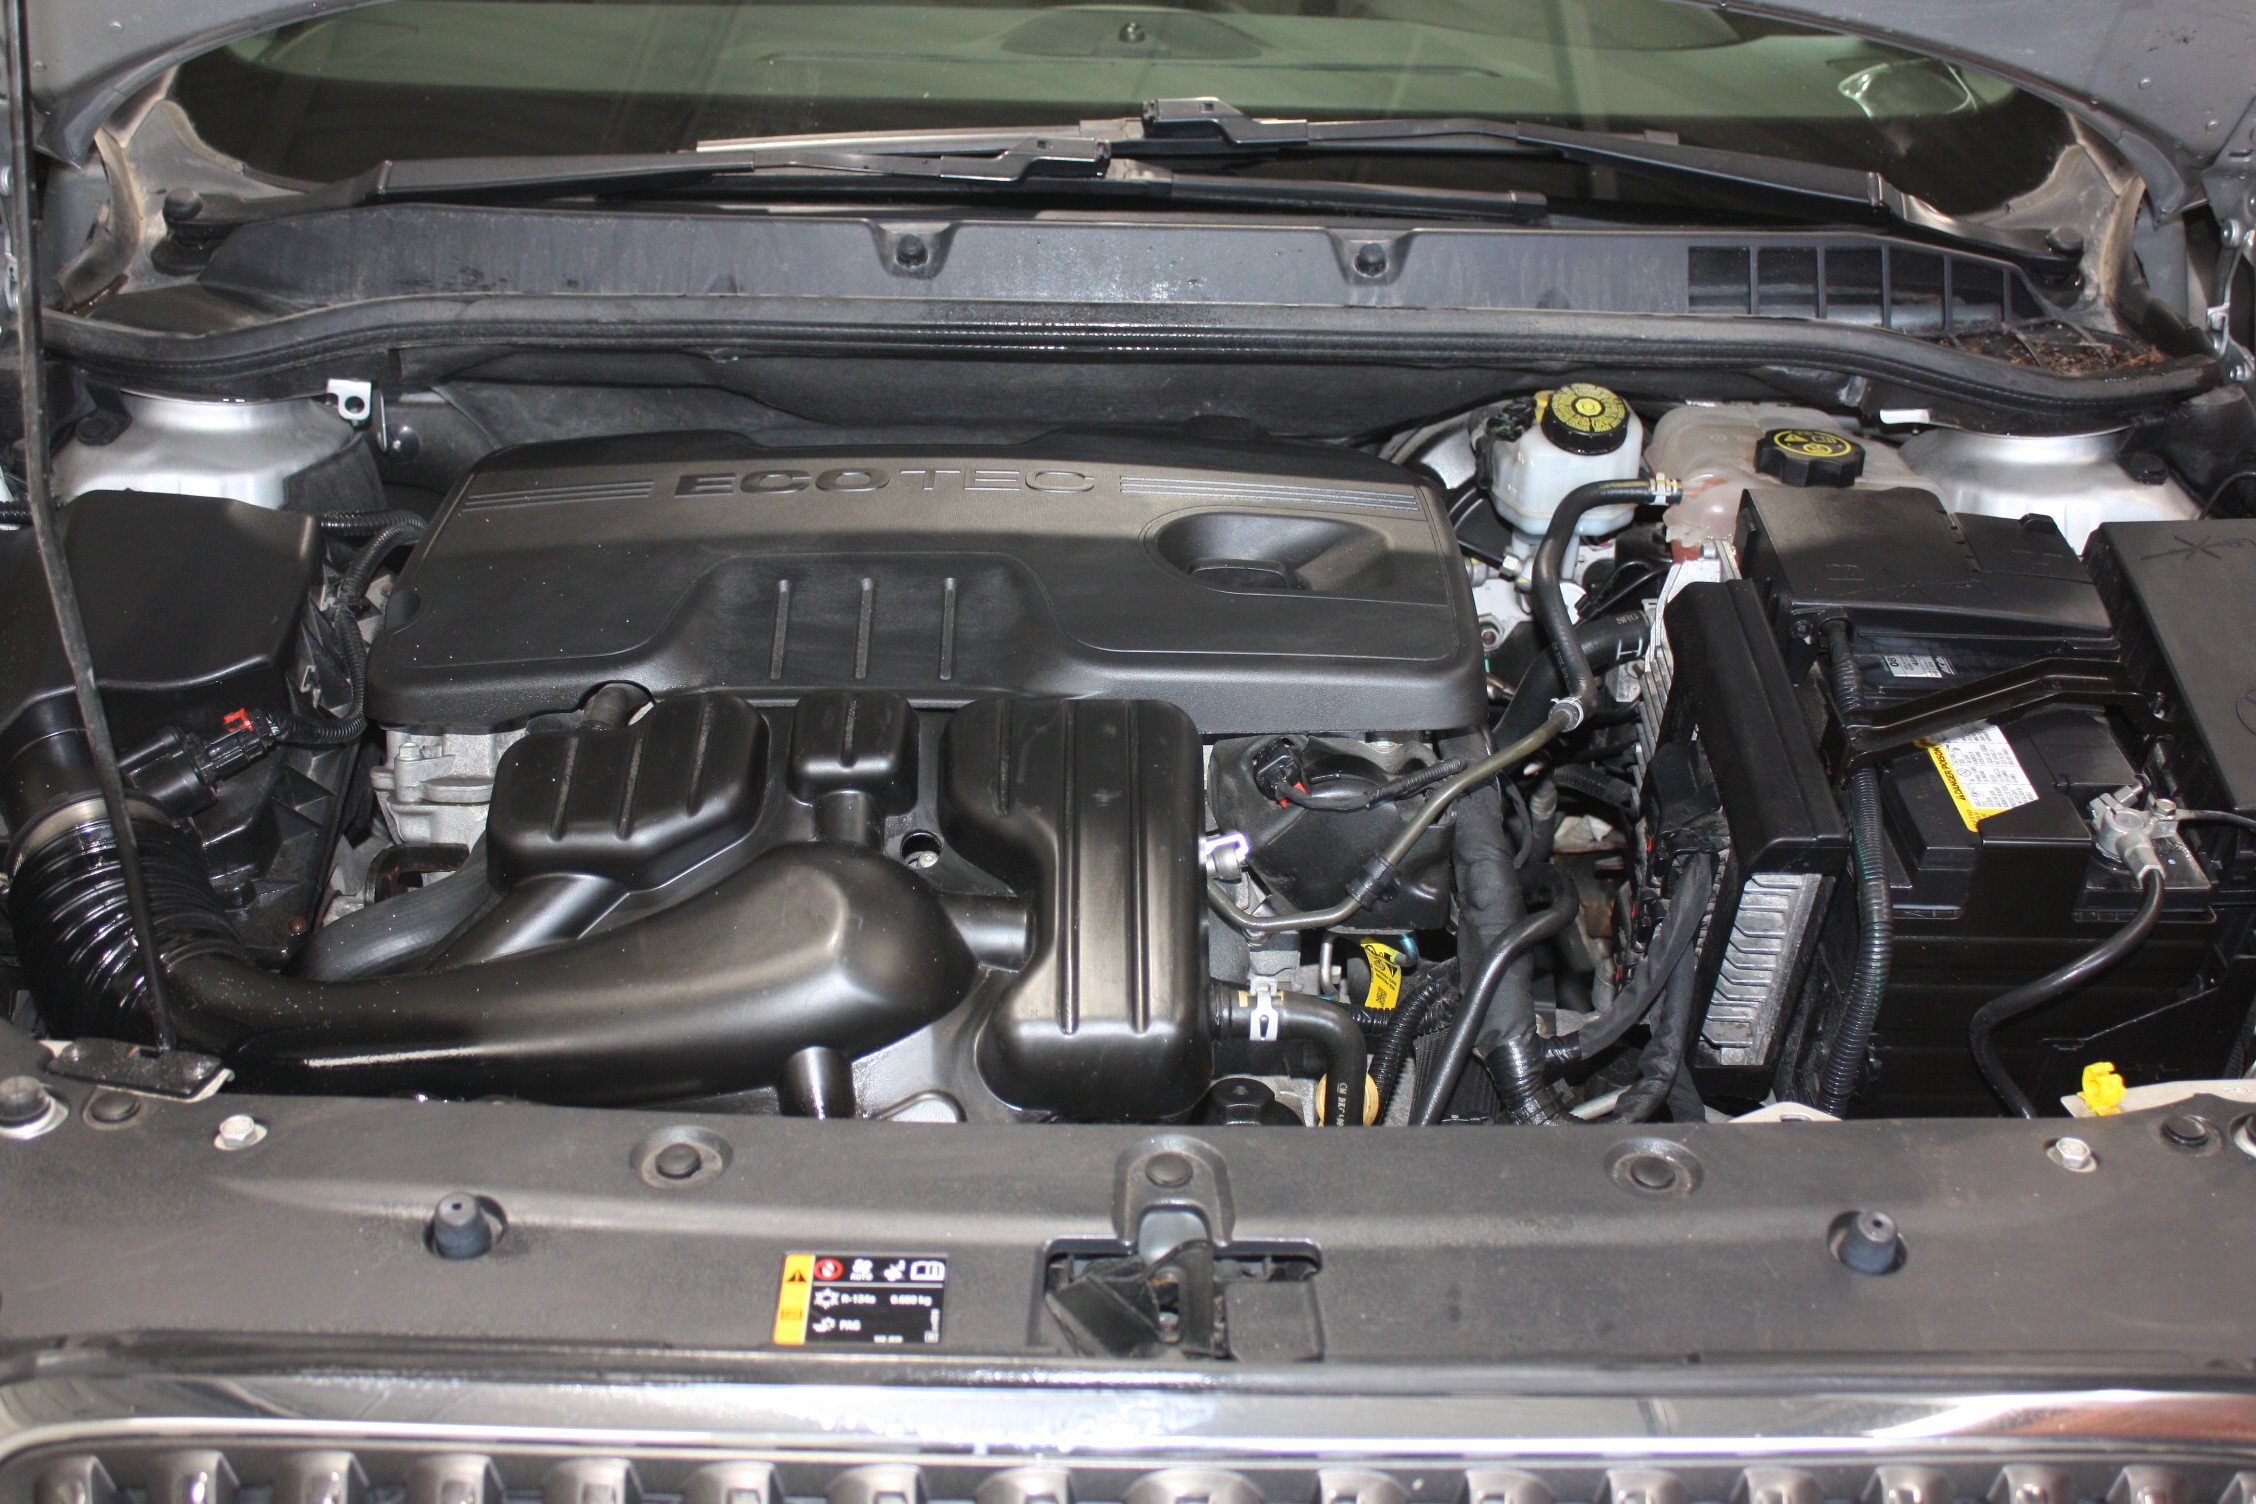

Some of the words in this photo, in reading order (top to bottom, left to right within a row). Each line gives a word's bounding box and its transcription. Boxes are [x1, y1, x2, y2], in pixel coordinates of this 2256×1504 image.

[674, 467, 1096, 498] ECOTEC
[850, 1272, 874, 1281] AUTO
[841, 1293, 877, 1305] R-134a
[918, 1295, 933, 1307] kg
[838, 1318, 862, 1332] PAG
